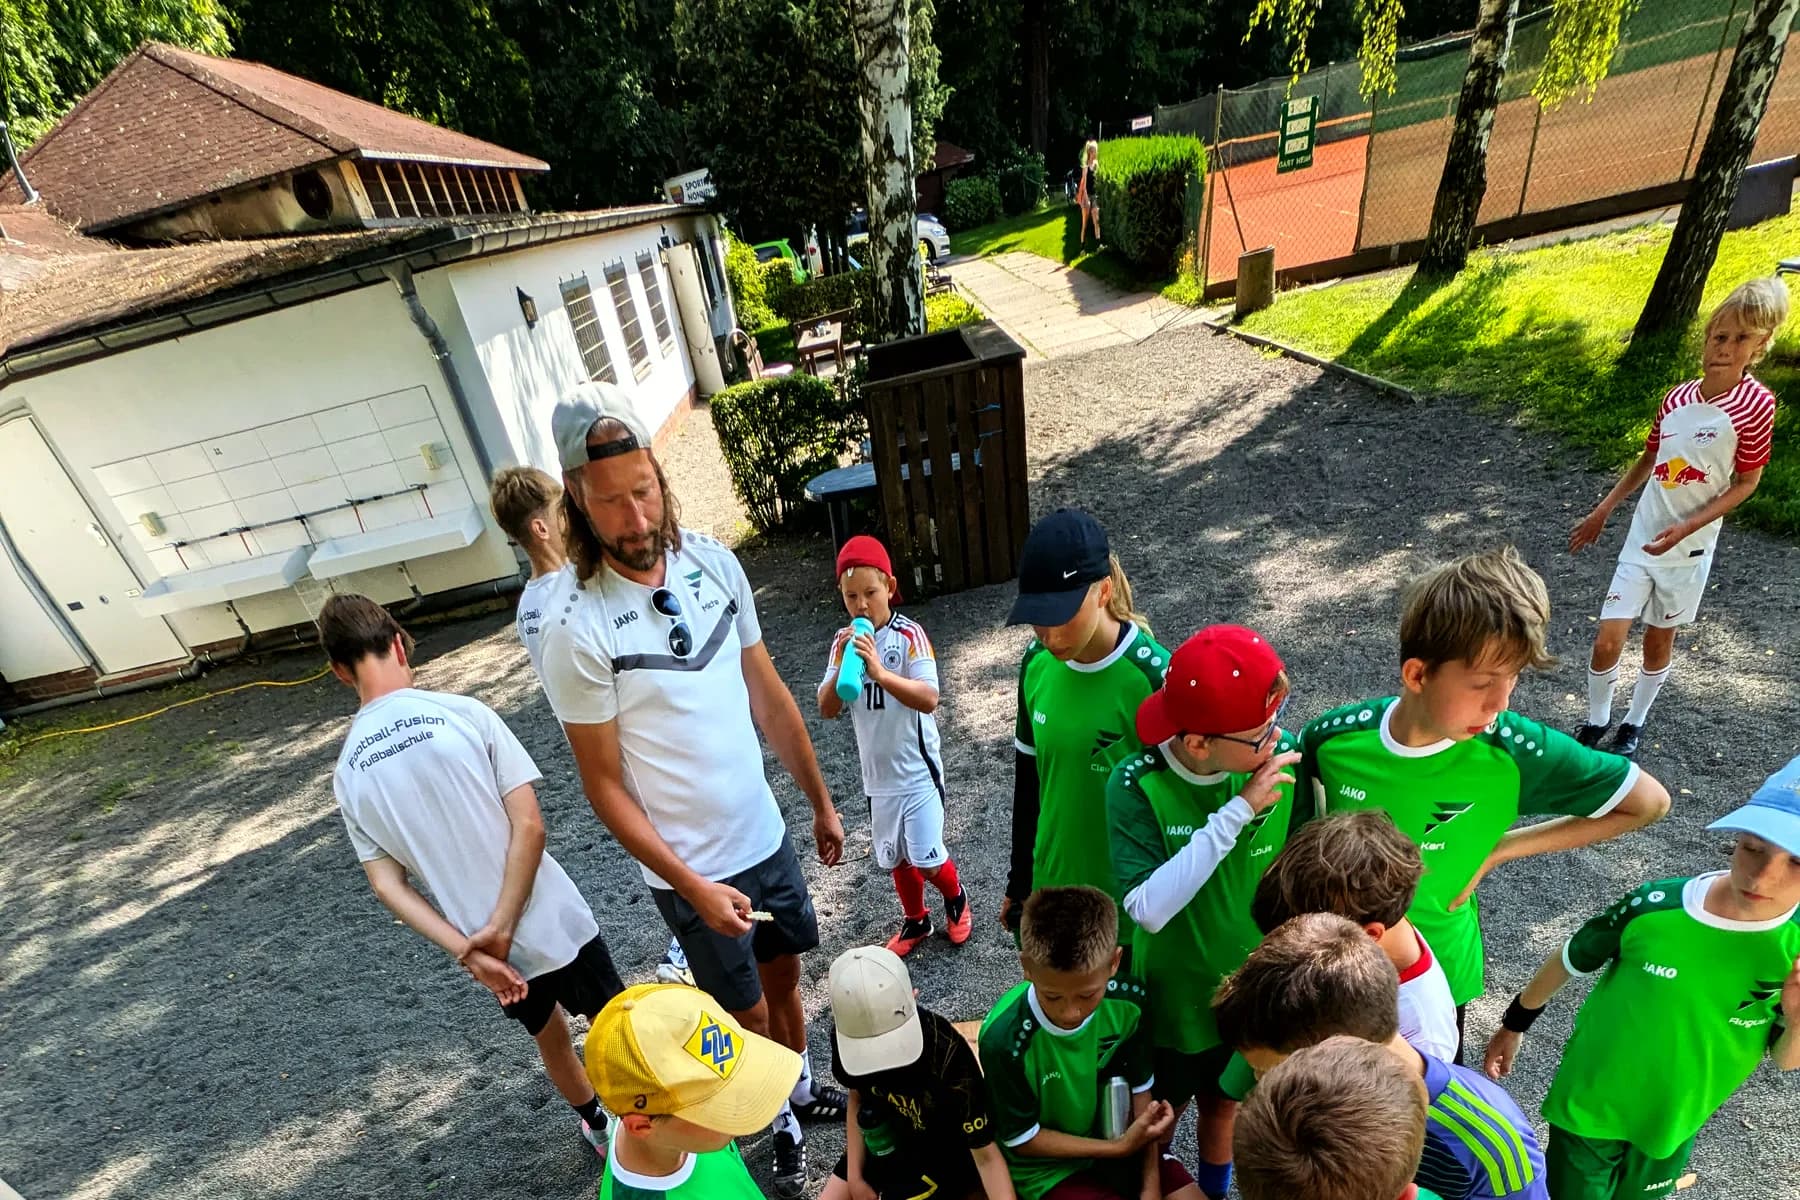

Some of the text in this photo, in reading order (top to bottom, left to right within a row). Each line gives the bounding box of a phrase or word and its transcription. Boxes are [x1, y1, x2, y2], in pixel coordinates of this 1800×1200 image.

[613, 610, 639, 630] JAKO
[348, 714, 446, 771] Football-Fusion
[359, 730, 434, 772] Fußballschule
[1339, 784, 1367, 801] JAKO
[1166, 825, 1193, 836] JAKO
[1642, 961, 1678, 979] JAKO
